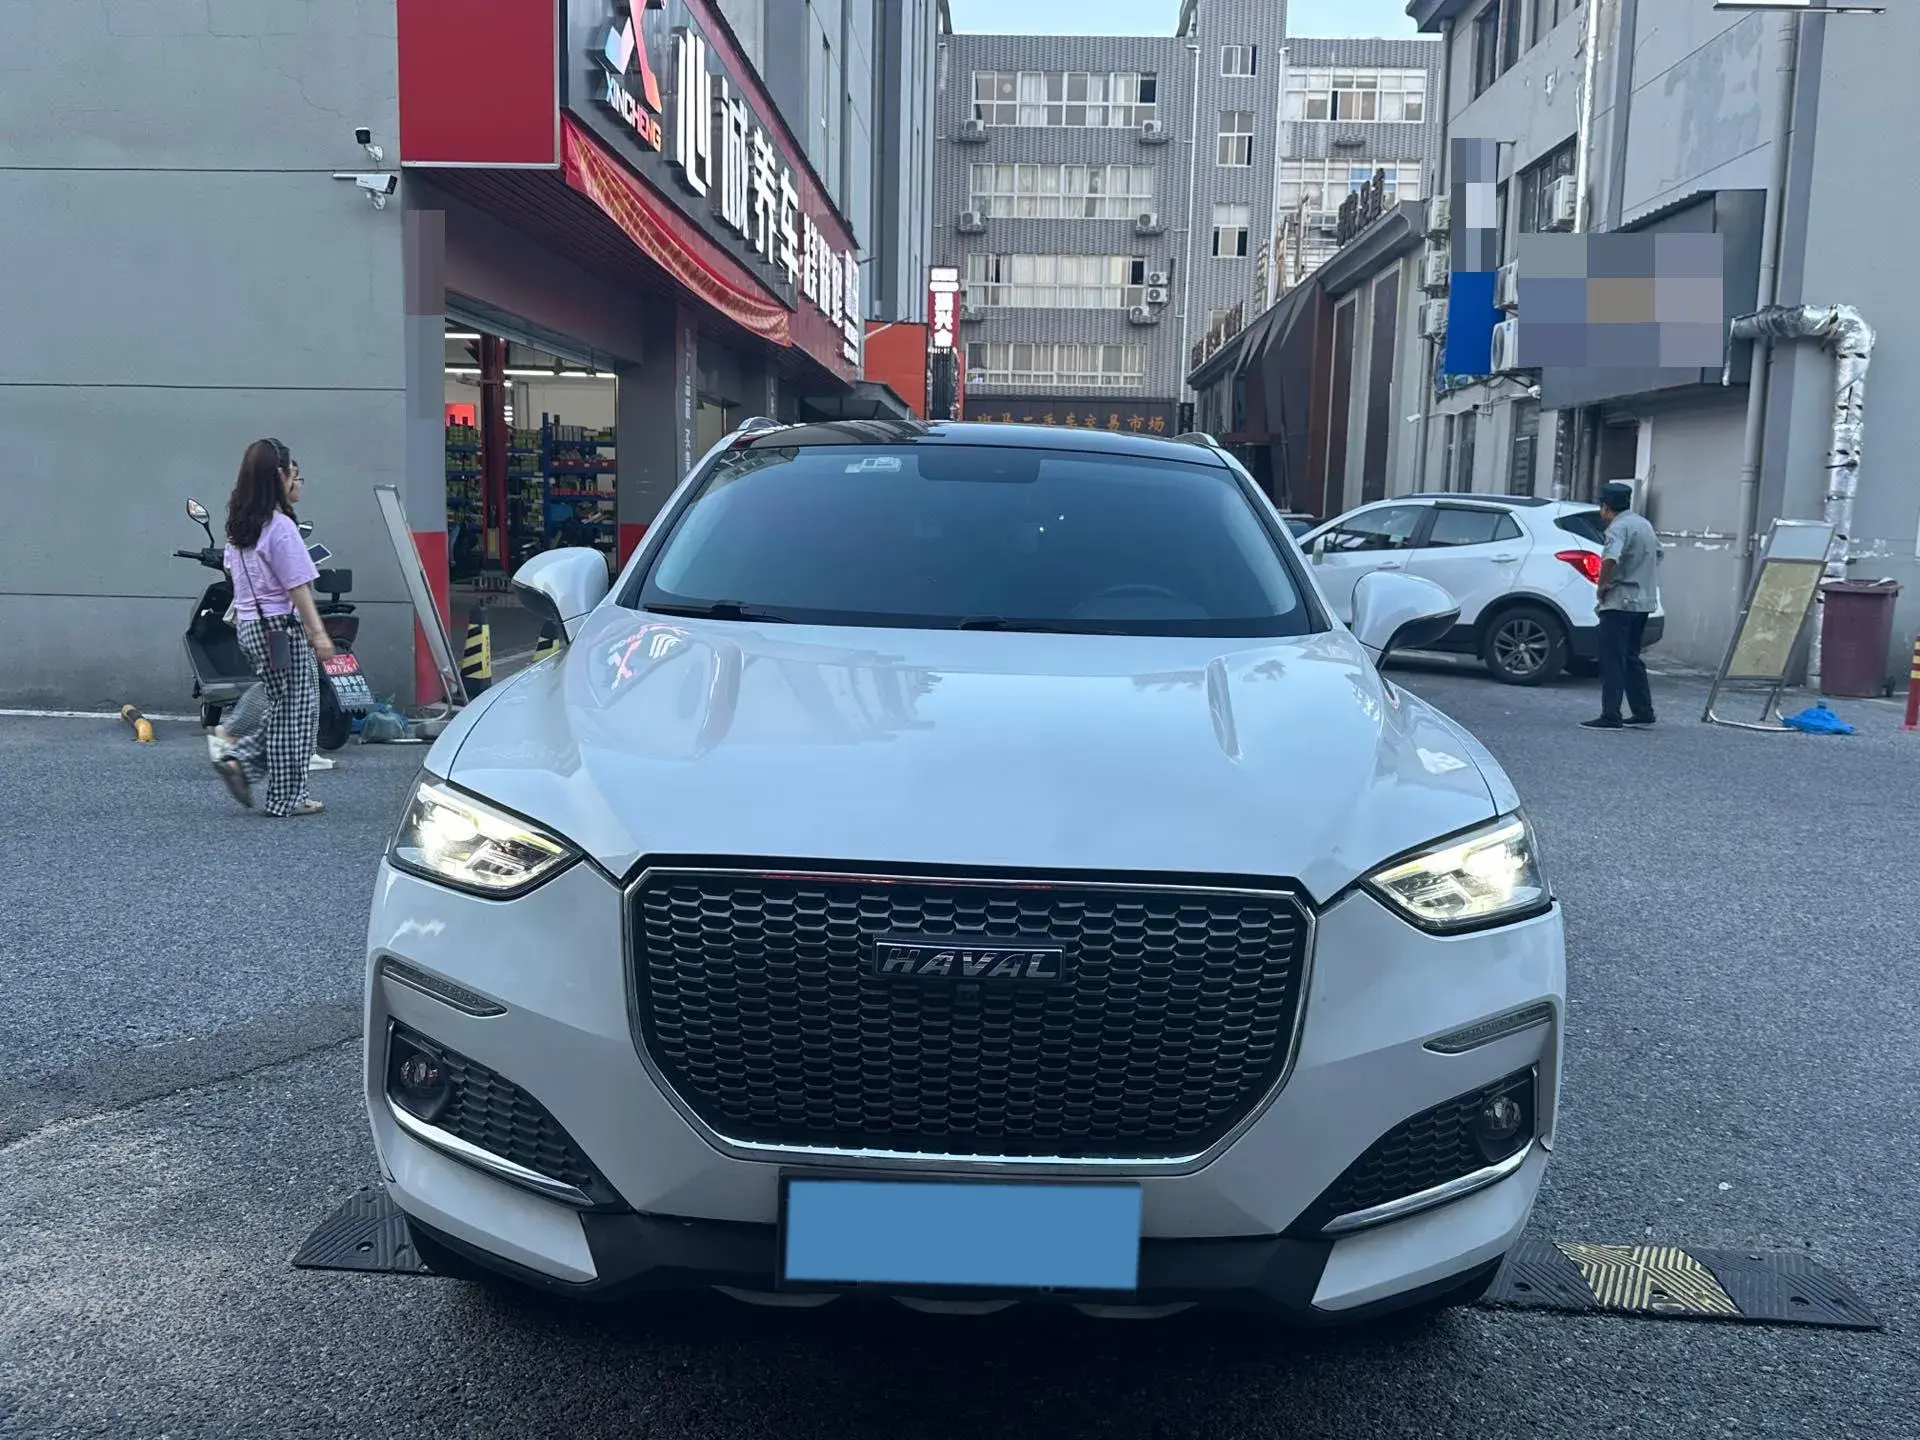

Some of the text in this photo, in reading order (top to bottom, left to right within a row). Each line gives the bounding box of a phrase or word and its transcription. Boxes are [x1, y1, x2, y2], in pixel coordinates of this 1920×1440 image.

[604, 70, 662, 152] XINCHENG
[675, 26, 799, 284] 心诚养车
[881, 947, 1057, 979] HAVAL
